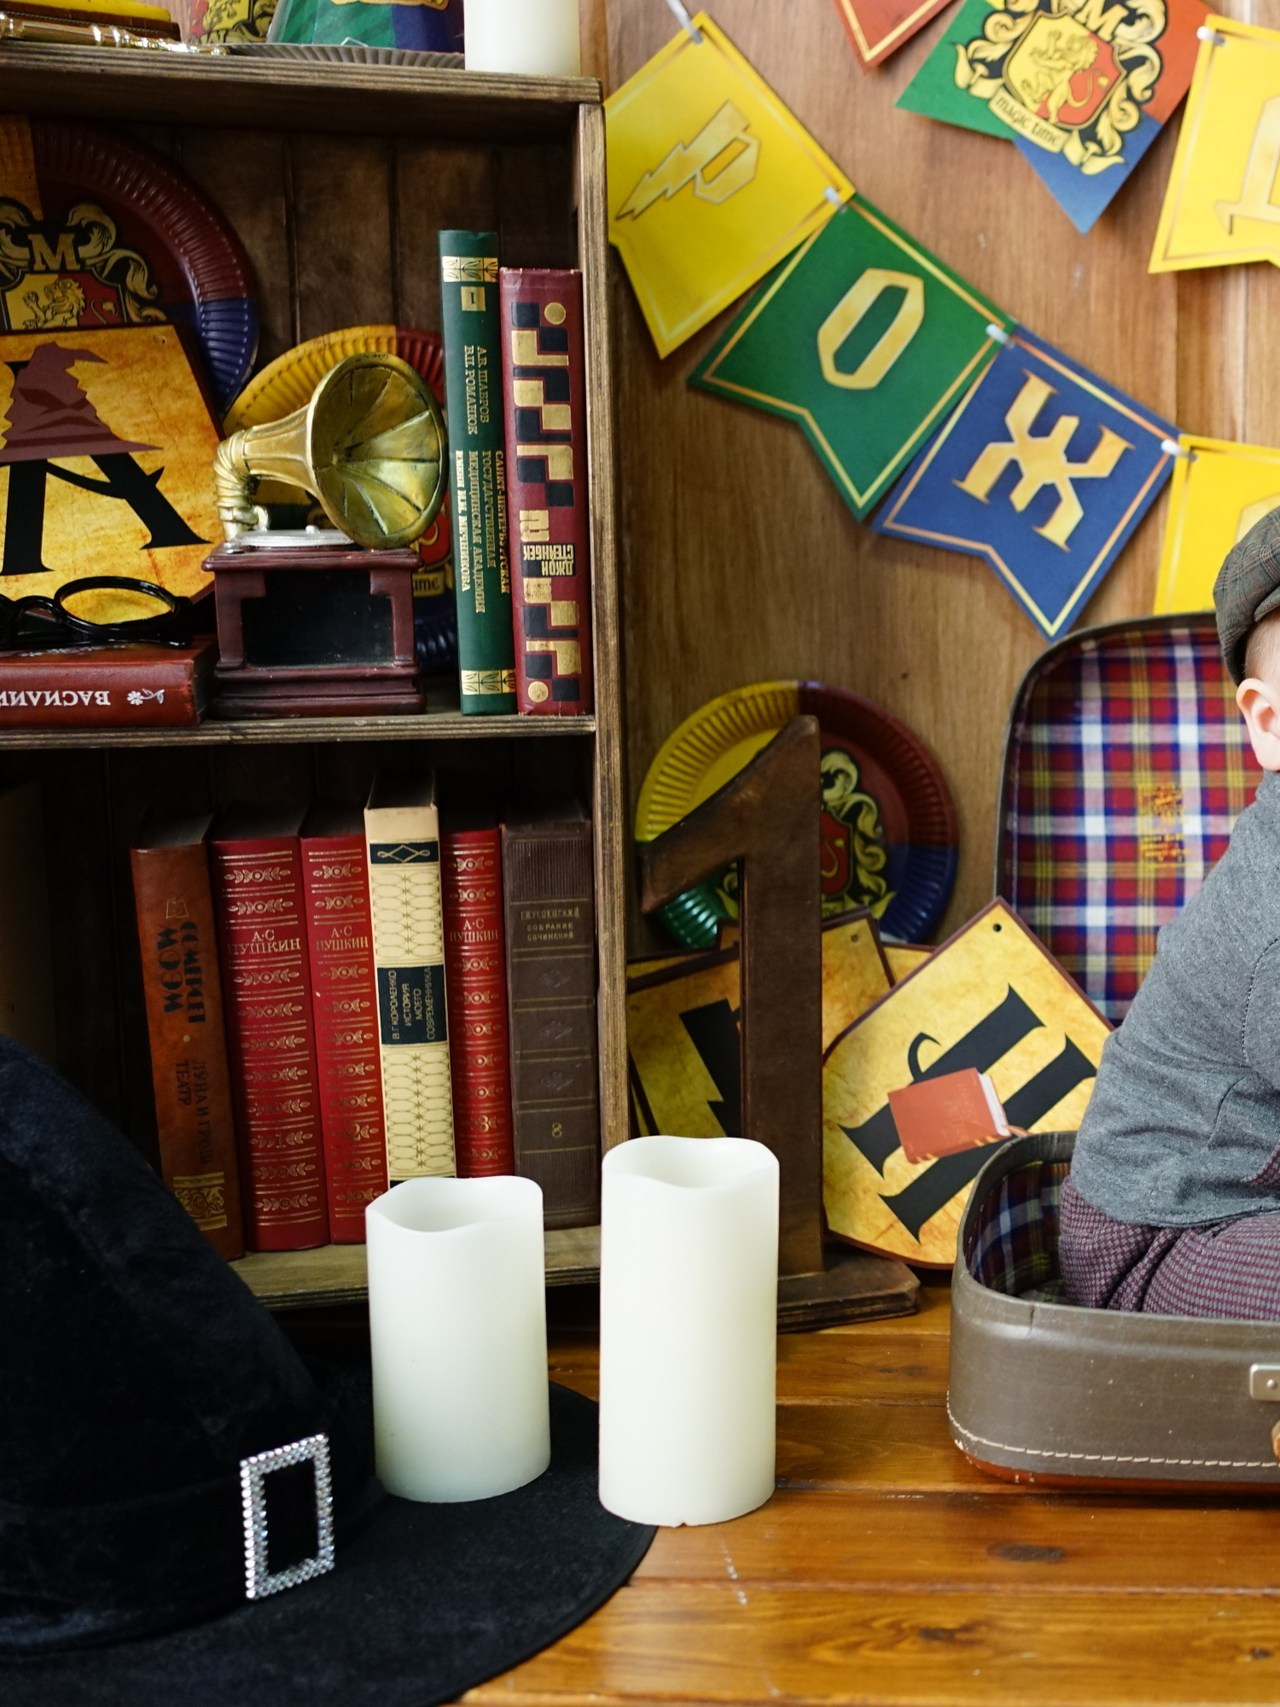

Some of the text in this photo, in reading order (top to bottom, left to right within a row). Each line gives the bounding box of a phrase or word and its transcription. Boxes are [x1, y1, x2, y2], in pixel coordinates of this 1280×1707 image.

[995, 93, 1060, 144] magic time
[28, 233, 80, 271] M
[465, 369, 478, 435] РОМАНЮК
[478, 369, 490, 424] ШАБРОВ
[482, 450, 497, 568] ГОСУДАРСТВЕННАЯ
[459, 515, 471, 592] МЕЧНИКОВА
[468, 450, 486, 614] МЕДИЦИНСКАЯ АКАДЕМИЯ
[523, 544, 574, 561] СТЕЙНБЕК
[541, 560, 574, 576] ДЖОН
[228, 938, 301, 955] ПУШКИН
[315, 936, 369, 950] ПУШКИН
[450, 931, 499, 943] ПУШКИН
[527, 922, 573, 932] СОБРАНИЕ
[527, 931, 574, 942] СОЧИНЕНИЙ
[156, 924, 184, 1013] МОЭМ
[181, 921, 206, 1022] СОМЕРСЕТ
[402, 983, 411, 1026] ИСТОРИЯ
[414, 988, 422, 1020] МОЕГО
[425, 967, 435, 1040] СОВРЕМЕННИКА
[175, 1061, 192, 1105] ТЕАТР
[192, 1060, 208, 1104] ЛУНА
[551, 1121, 563, 1138] 8
